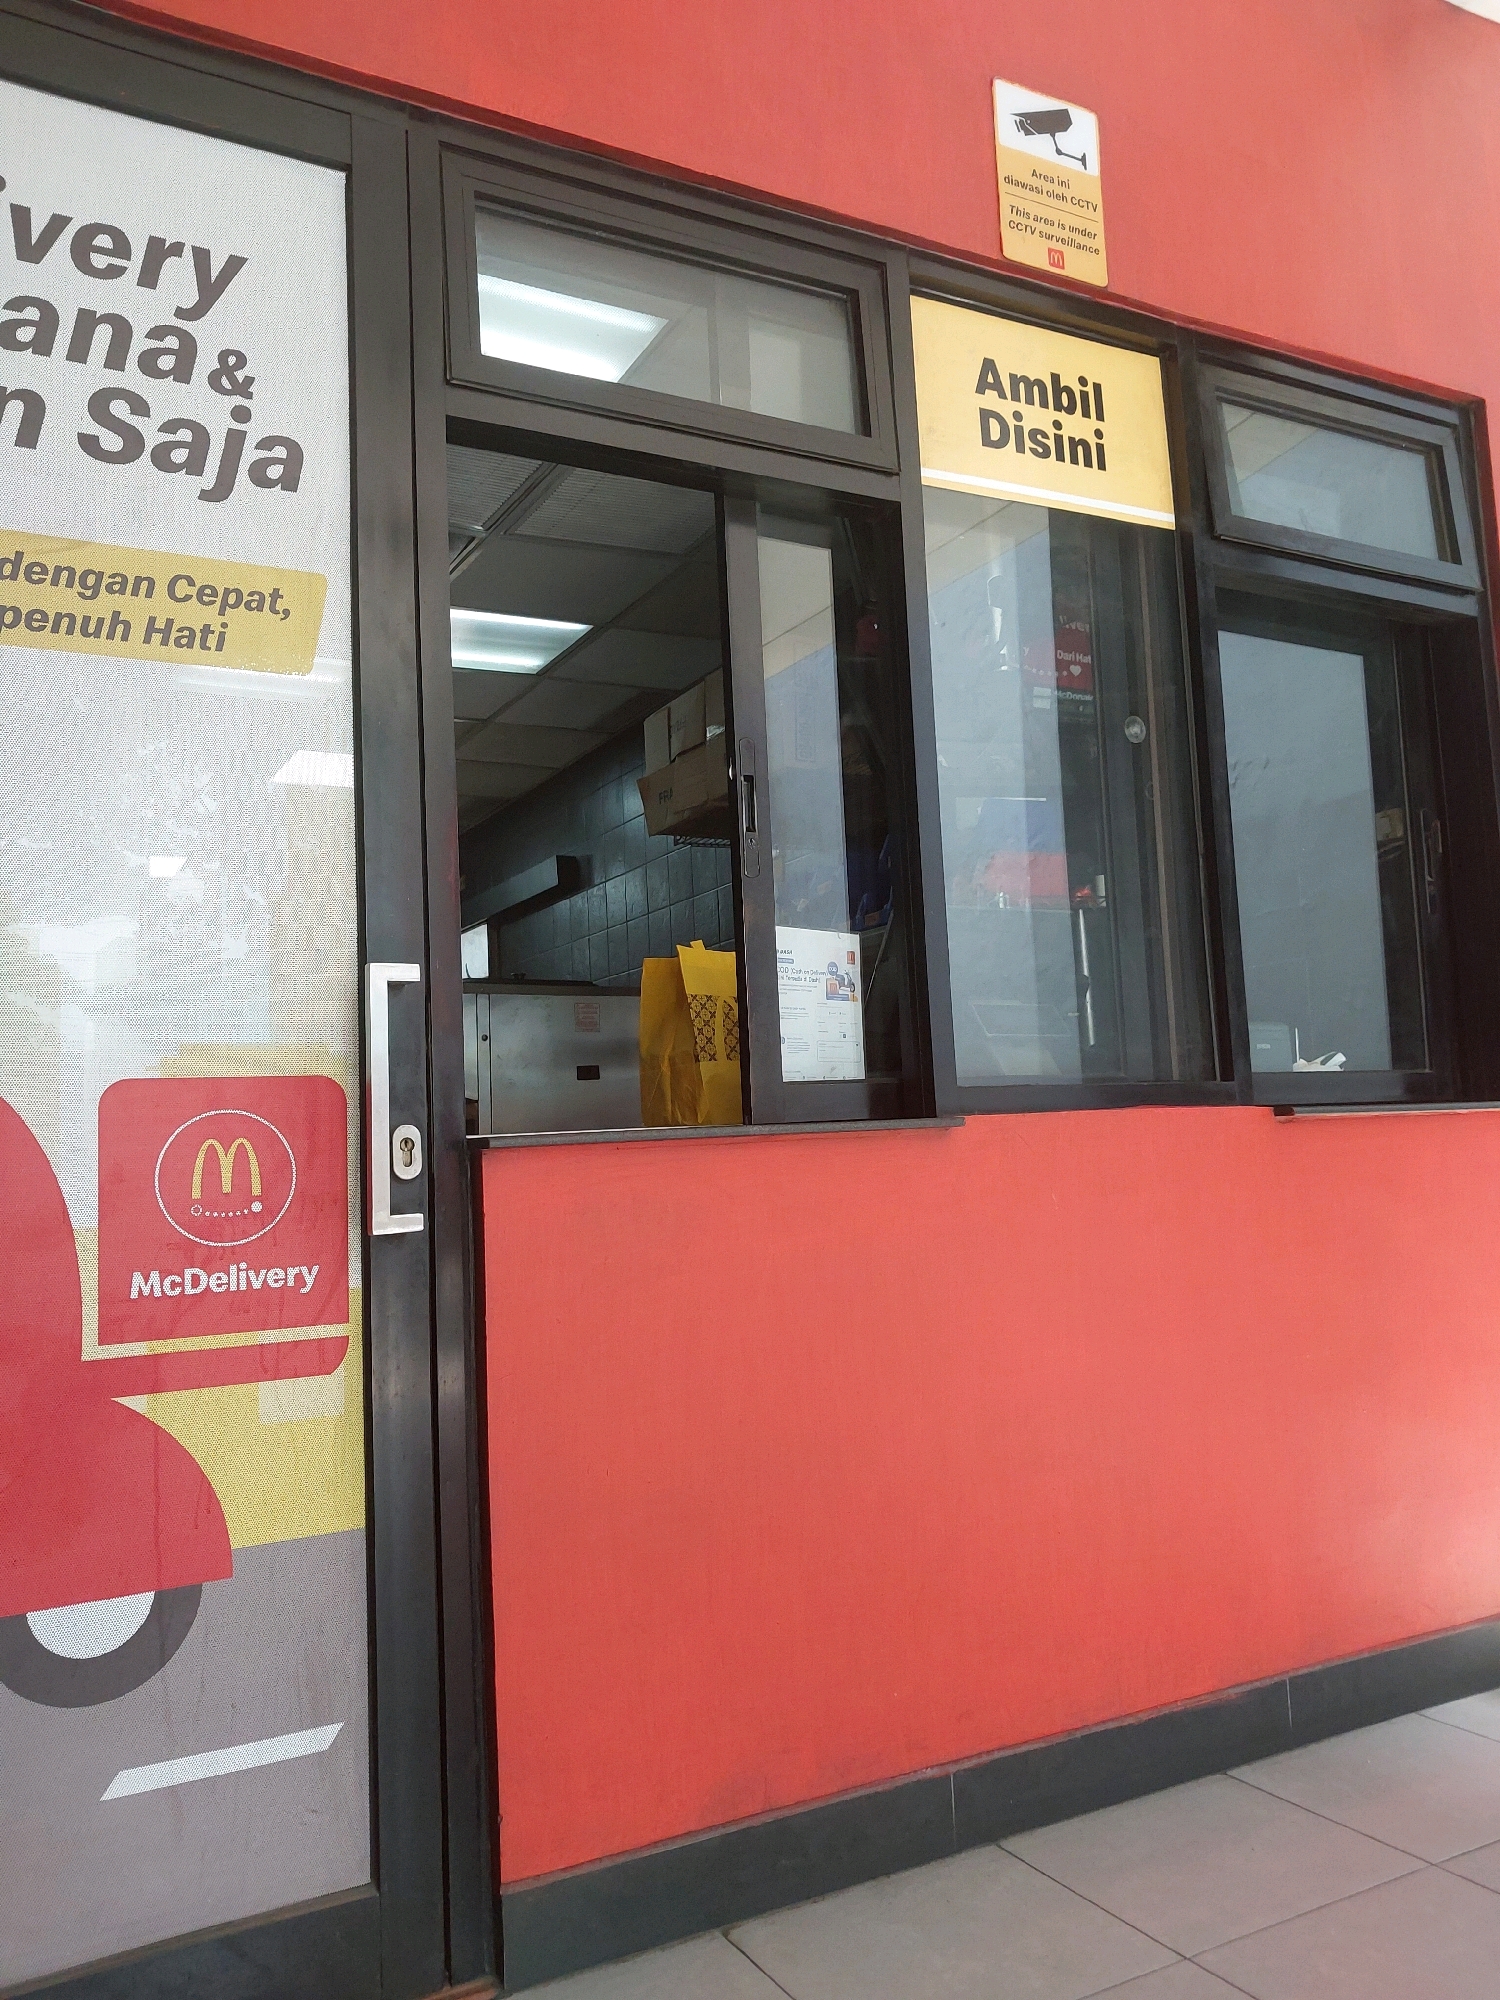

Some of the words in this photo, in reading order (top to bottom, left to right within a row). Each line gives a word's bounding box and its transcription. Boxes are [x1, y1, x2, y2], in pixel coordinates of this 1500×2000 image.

[1003, 174, 1044, 196] diawasi
[1046, 189, 1069, 204] oleh
[1070, 196, 1098, 213] CCTV
[1031, 168, 1055, 185] Area
[1057, 175, 1071, 190] ini
[1008, 219, 1037, 236] CCTV
[1038, 230, 1100, 256] surveillance
[1009, 204, 1031, 221] This
[1032, 213, 1055, 227] area
[1057, 218, 1067, 231] is
[1068, 223, 1098, 241] under
[0, 174, 248, 322] very
[207, 349, 256, 400] &
[975, 356, 1105, 422] Ambil
[77, 387, 304, 503] Saja
[979, 407, 1107, 472] Disini
[0, 550, 156, 600] dengan
[167, 574, 291, 621] Cepat,
[0, 604, 132, 642] penuh
[142, 615, 229, 653] Hati
[130, 1262, 320, 1300] McDelivery
